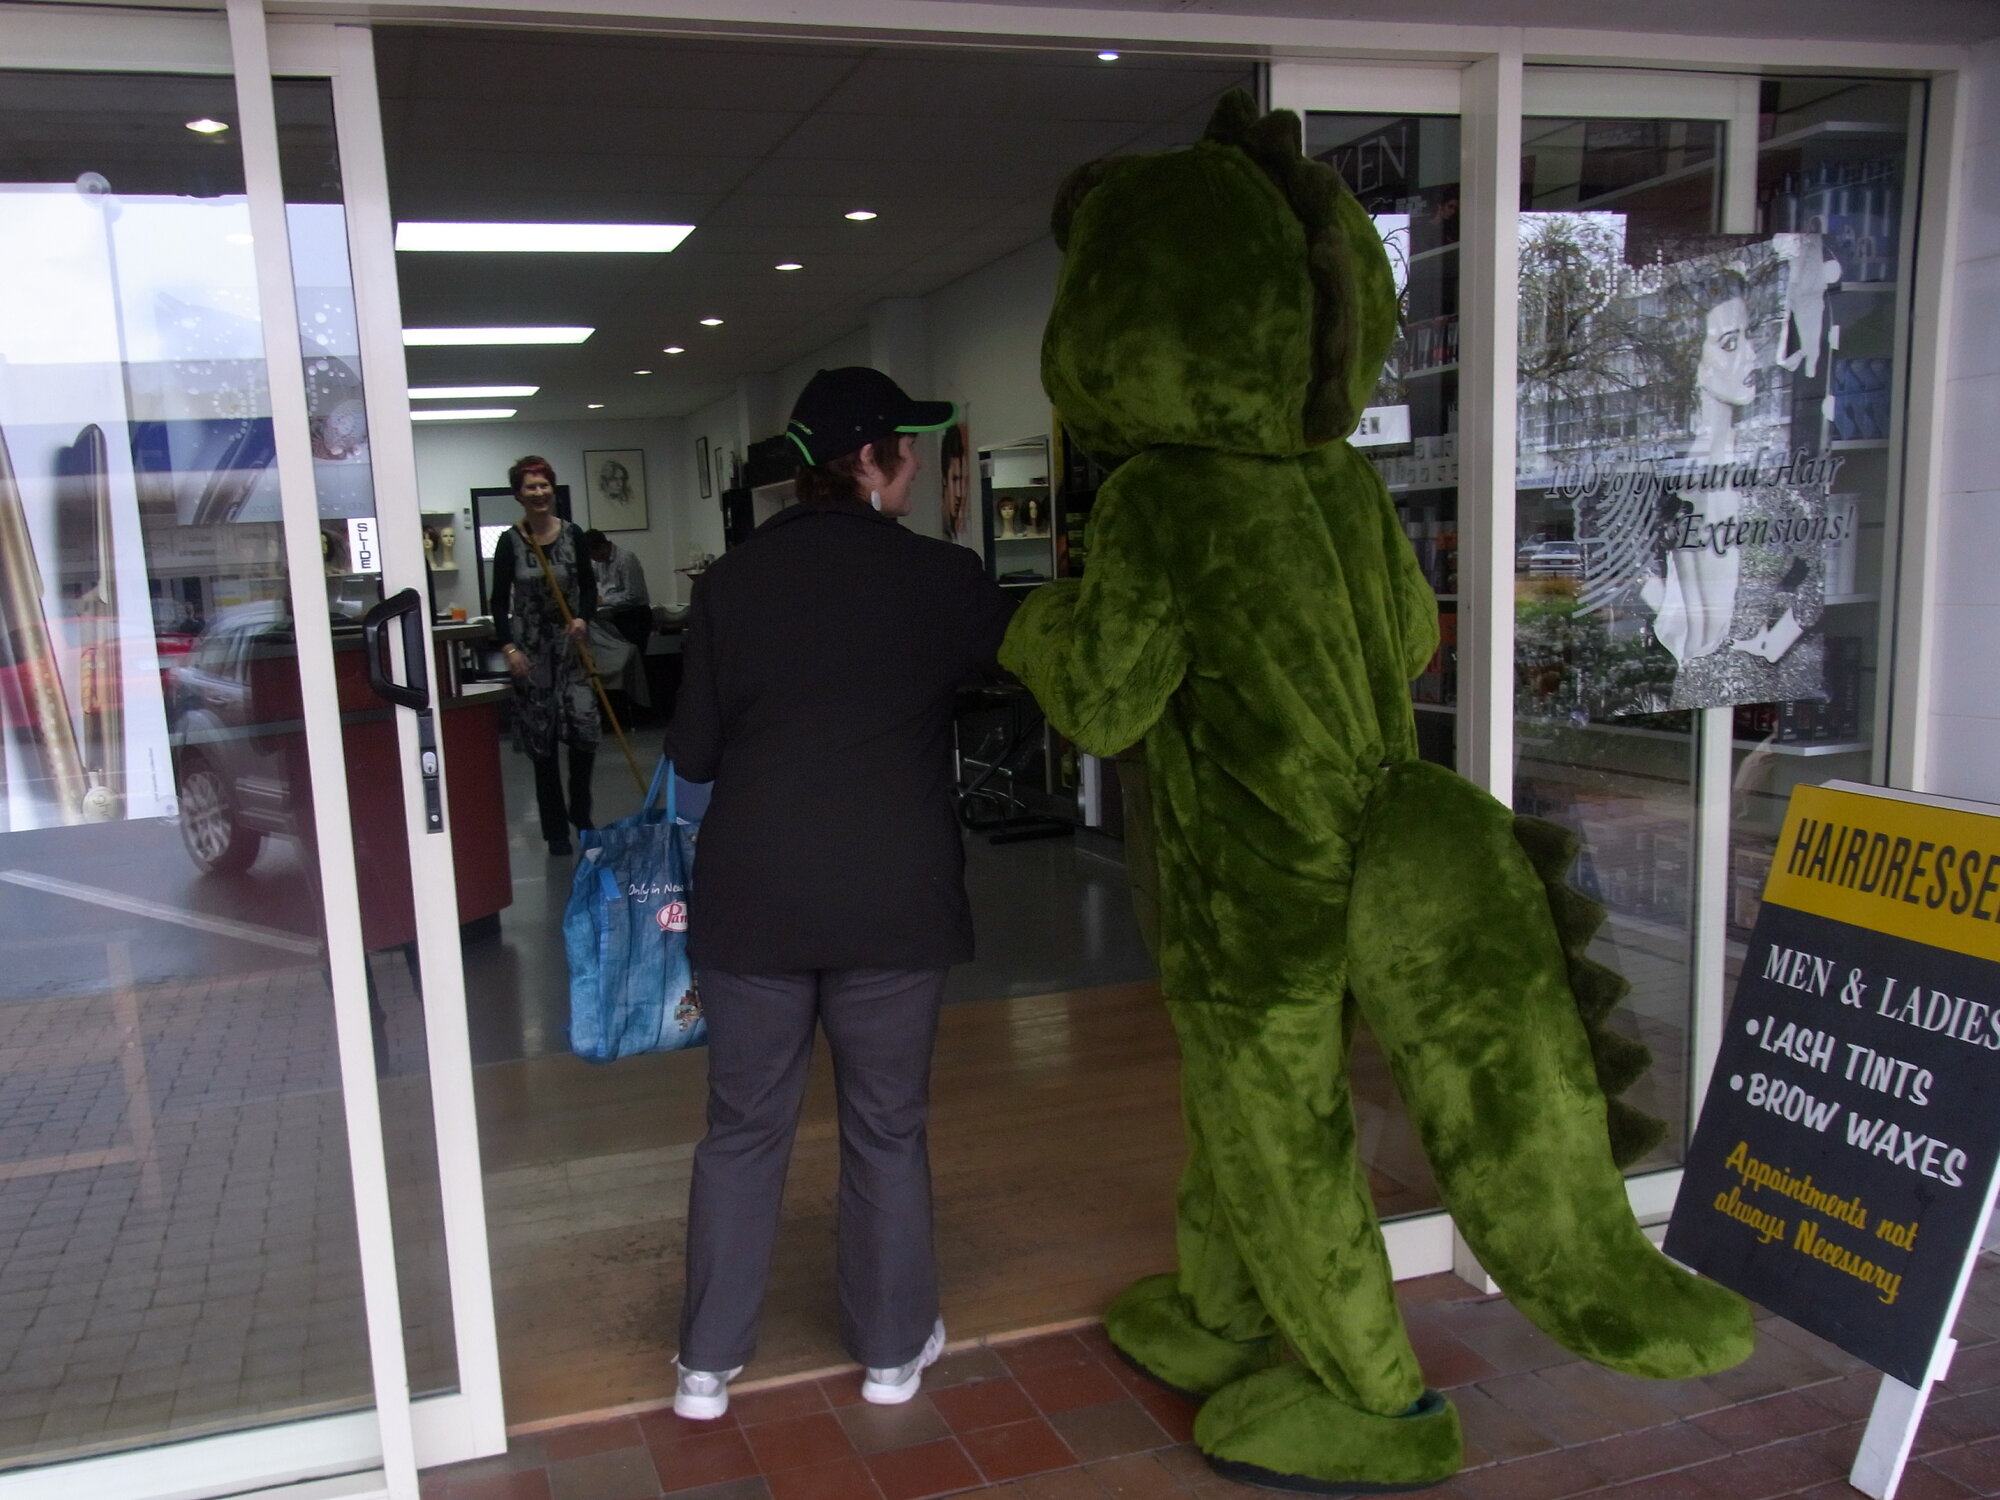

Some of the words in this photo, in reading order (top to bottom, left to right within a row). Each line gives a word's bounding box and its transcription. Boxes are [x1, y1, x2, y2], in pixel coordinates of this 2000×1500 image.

[1632, 451, 1762, 495] Natural
[1767, 446, 1846, 488] Hair
[357, 522, 372, 569] SLIDE
[1675, 502, 1856, 556] Extensions!
[651, 883, 661, 895] in
[1787, 817, 2000, 924] HAIRDRESSE
[1762, 943, 1836, 998] MEN
[1840, 967, 1868, 1009] &
[1759, 1015, 1836, 1074] LASH
[1844, 1043, 1934, 1106] TINTS
[1746, 1072, 1840, 1133] BROW
[1846, 1111, 1968, 1188] WAXES
[1725, 1140, 1867, 1230] Appointments
[1875, 1218, 1919, 1251] not
[1712, 1186, 1786, 1244] always
[1793, 1219, 1902, 1305] Necessary
